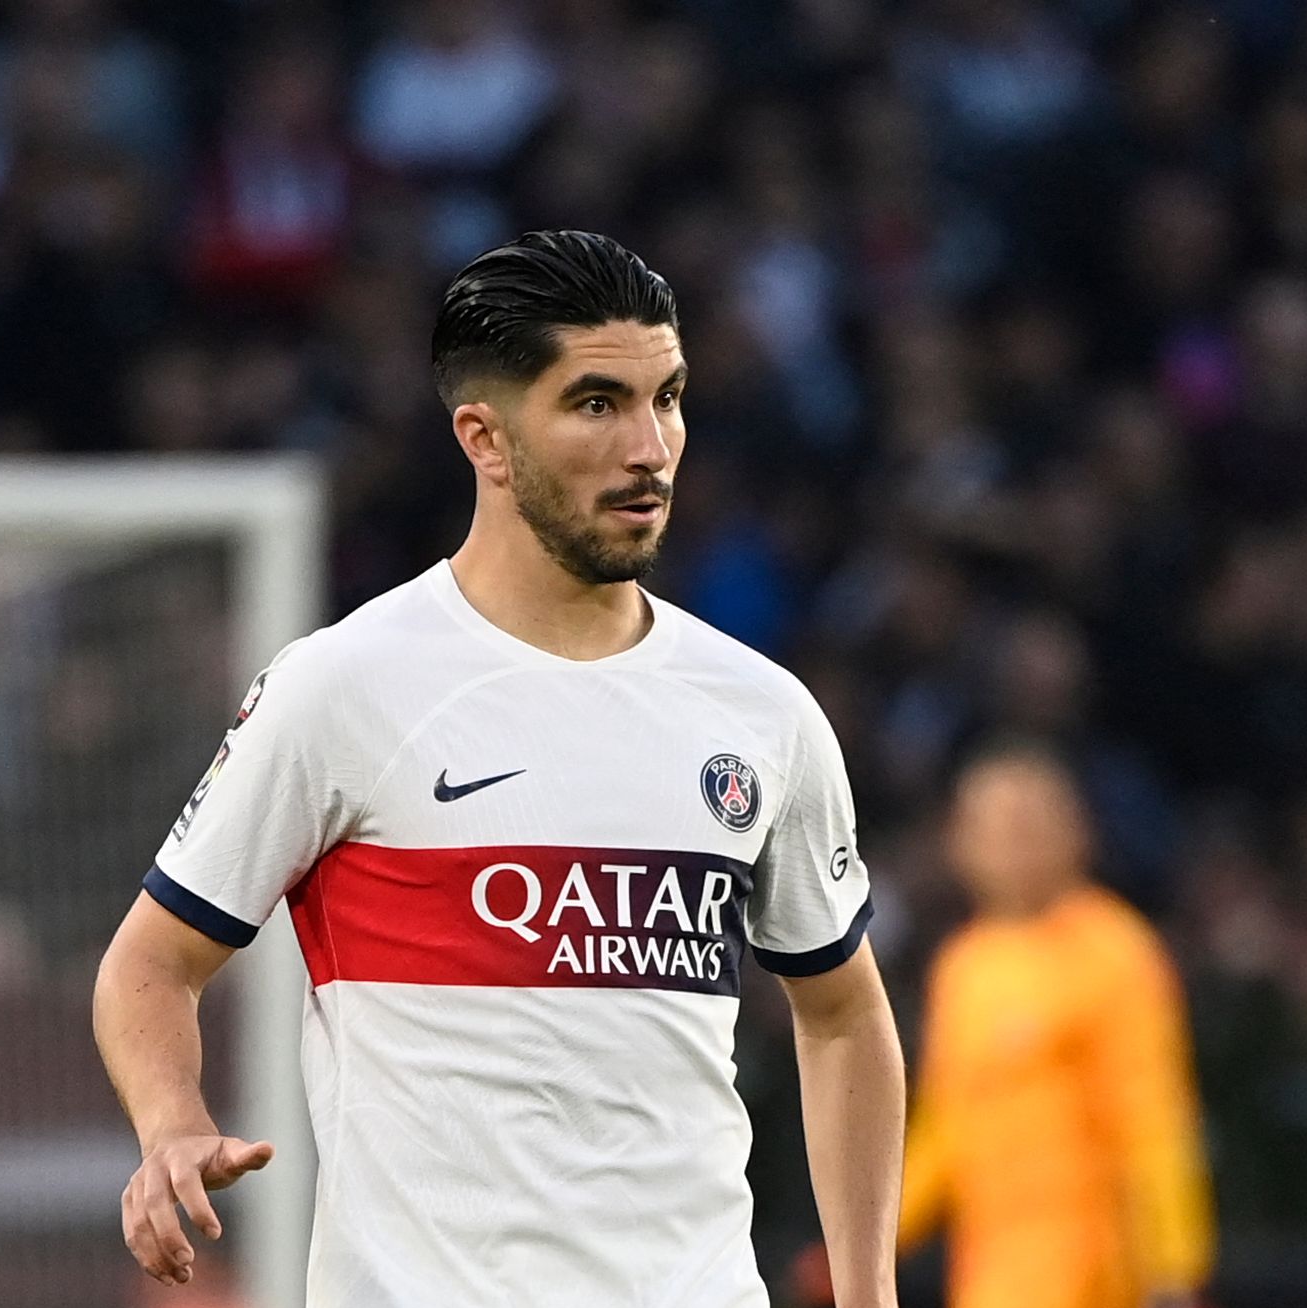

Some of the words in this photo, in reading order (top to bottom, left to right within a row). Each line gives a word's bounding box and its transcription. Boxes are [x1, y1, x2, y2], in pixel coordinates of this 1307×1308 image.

[710, 759, 752, 781] PARIS
[471, 862, 733, 943] QATAR
[546, 933, 725, 982] AIRWAYS
